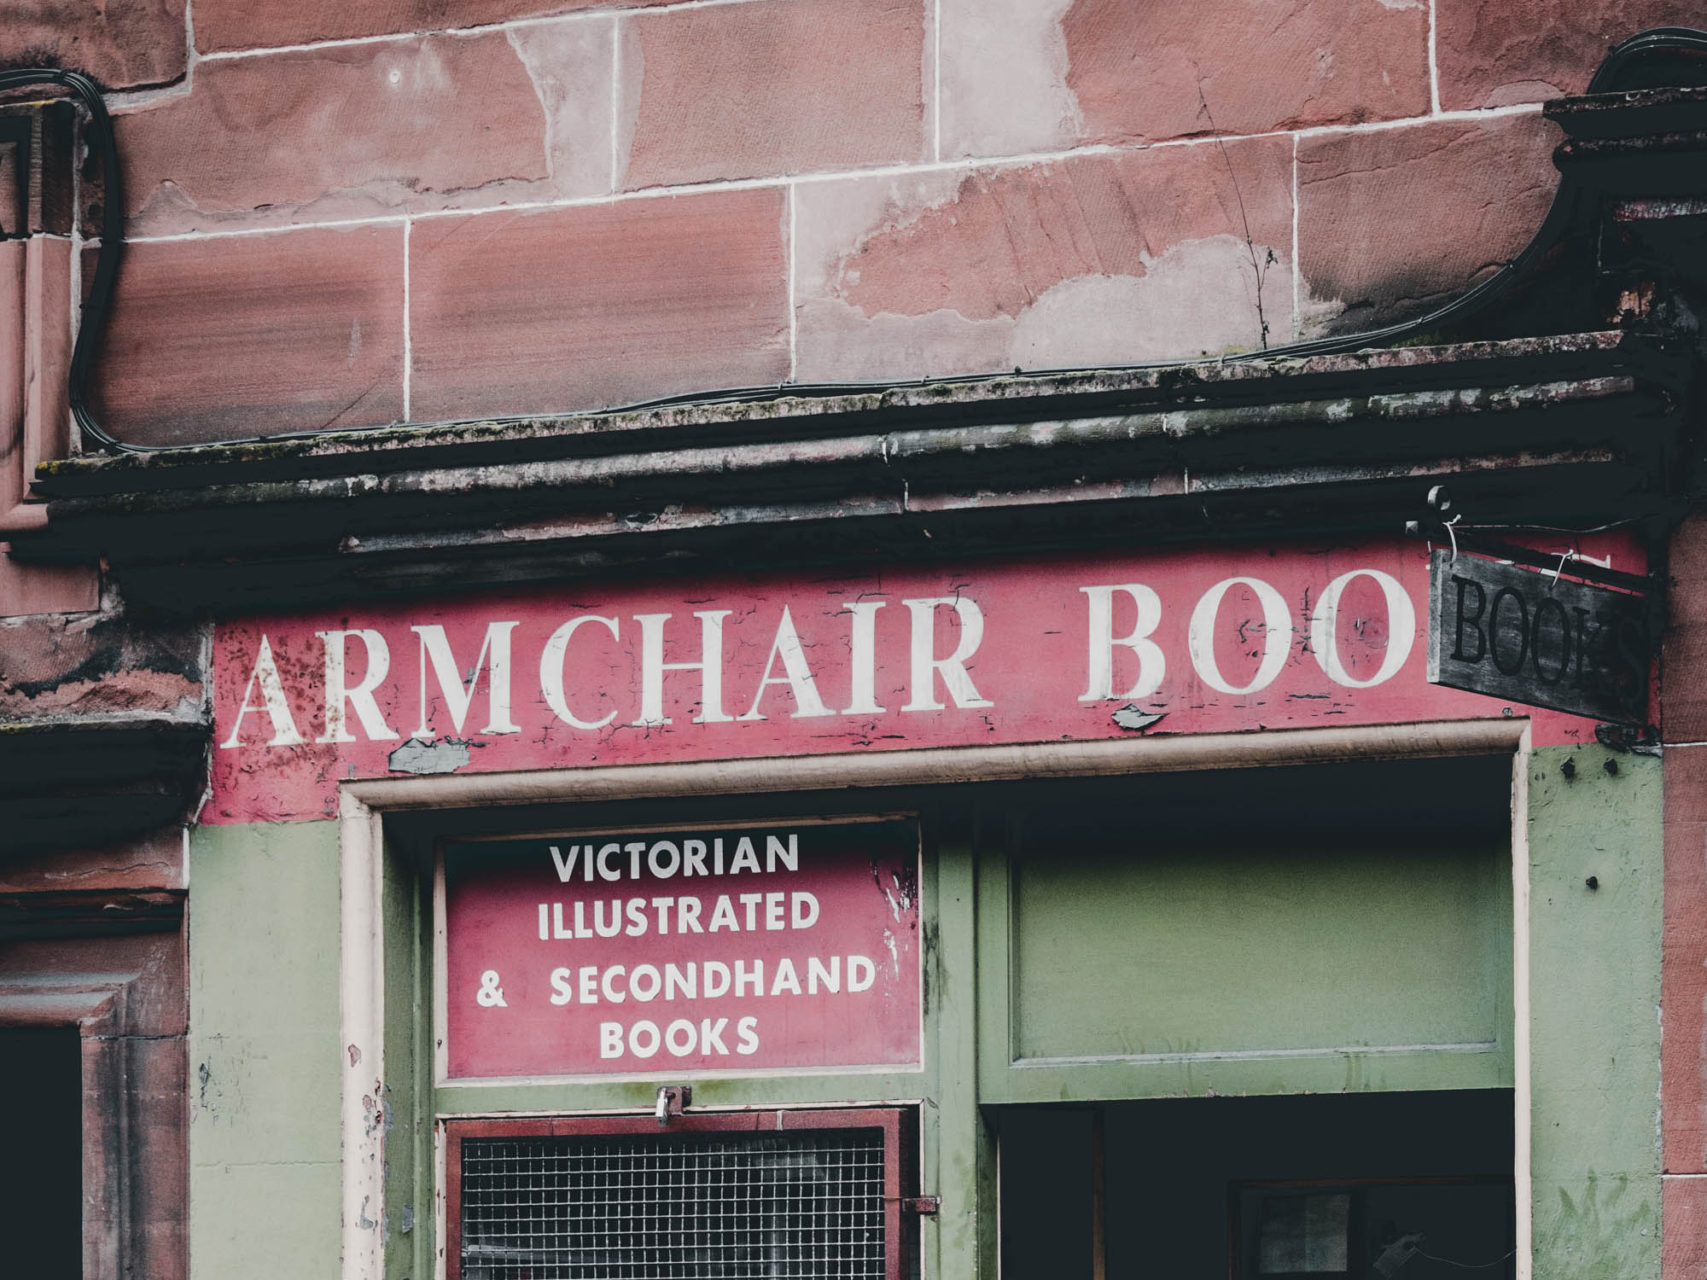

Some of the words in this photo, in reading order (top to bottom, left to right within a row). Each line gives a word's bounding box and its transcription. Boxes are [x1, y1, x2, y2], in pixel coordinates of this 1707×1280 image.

[220, 597, 994, 749] ARMCHAIR
[1078, 552, 1611, 703] BOO
[549, 834, 799, 883] VICTORIAN
[538, 892, 820, 941] ILLUSTRATED
[475, 969, 508, 1008] &
[549, 955, 877, 1006] SECONDHAND
[600, 1016, 760, 1060] BOOKS
